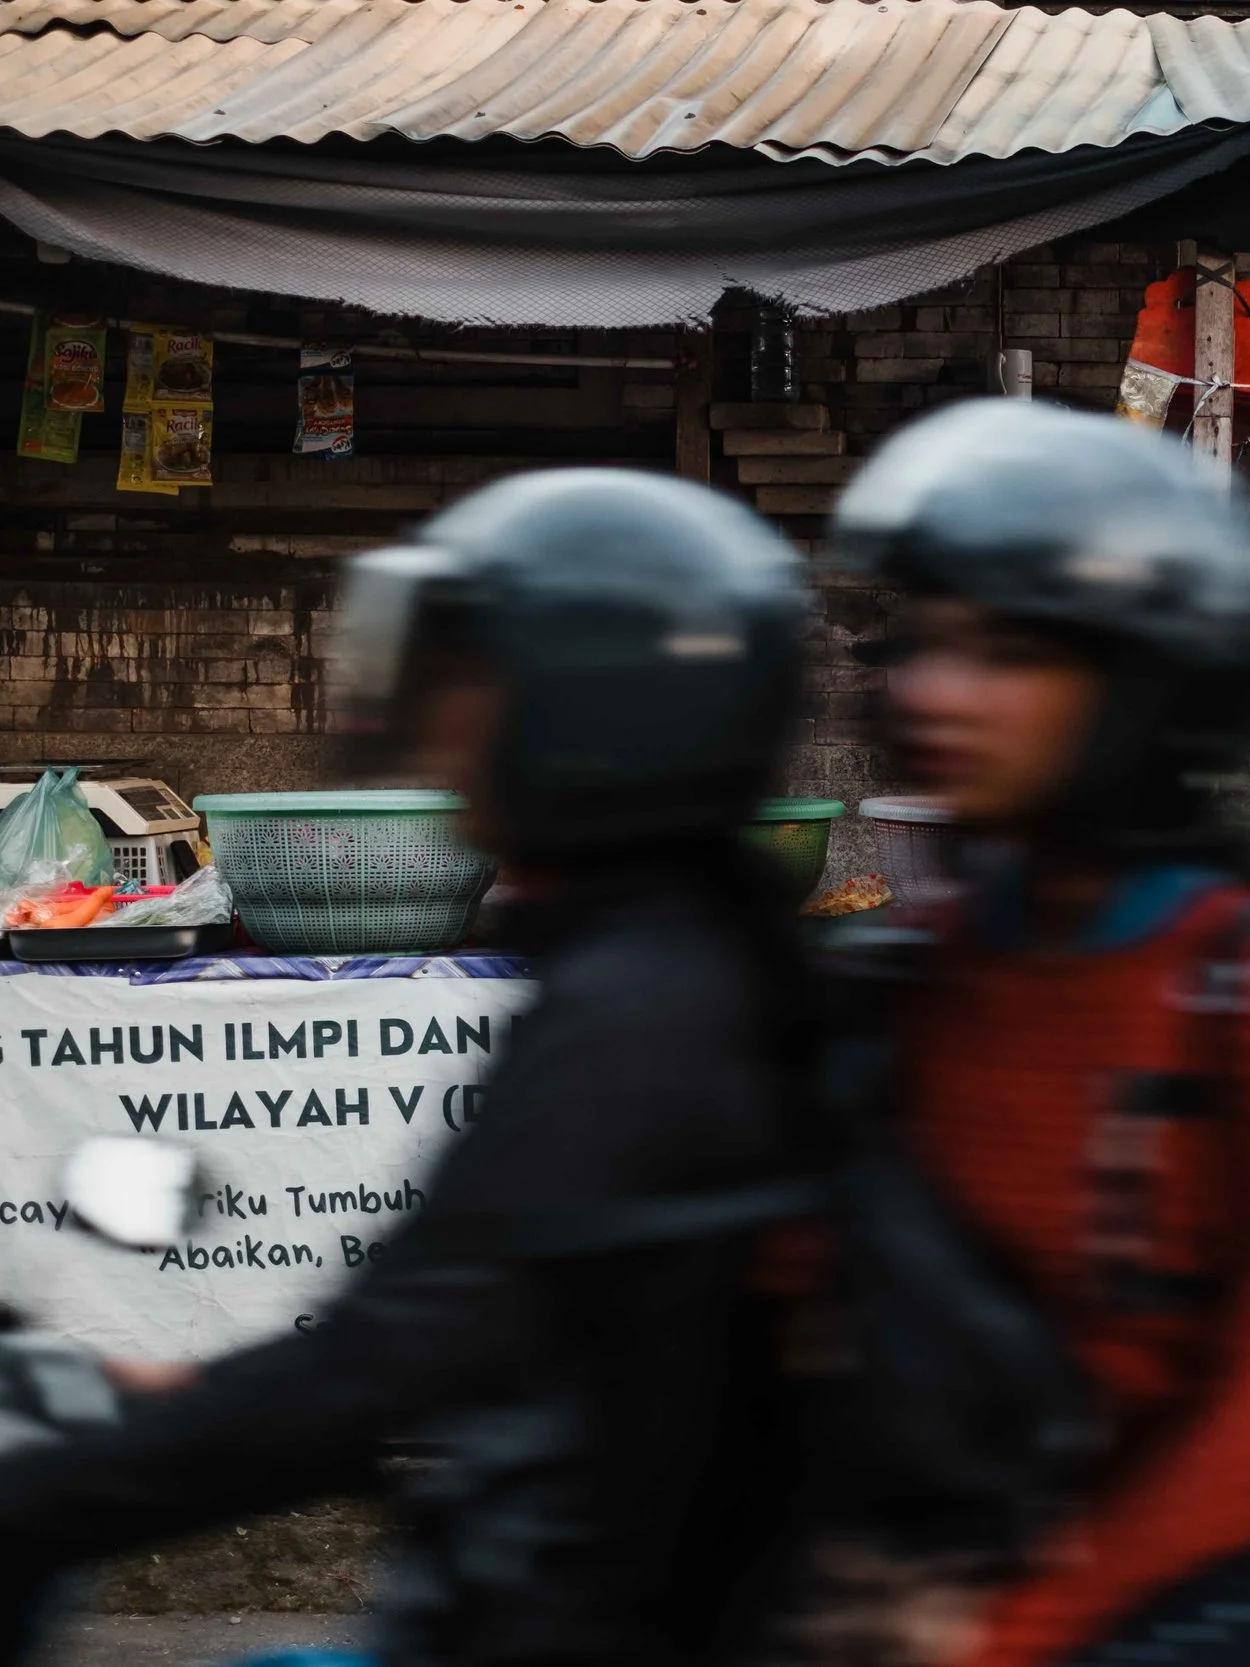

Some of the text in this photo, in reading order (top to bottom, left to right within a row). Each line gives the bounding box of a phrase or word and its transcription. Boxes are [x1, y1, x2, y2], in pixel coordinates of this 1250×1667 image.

[21, 1024, 204, 1066] TAHUN
[225, 1019, 358, 1060] ILMPI
[380, 1015, 491, 1056] DAN
[118, 1088, 369, 1133] WILAYAH
[388, 1086, 425, 1125] V
[285, 1179, 425, 1217] Tumbuh
